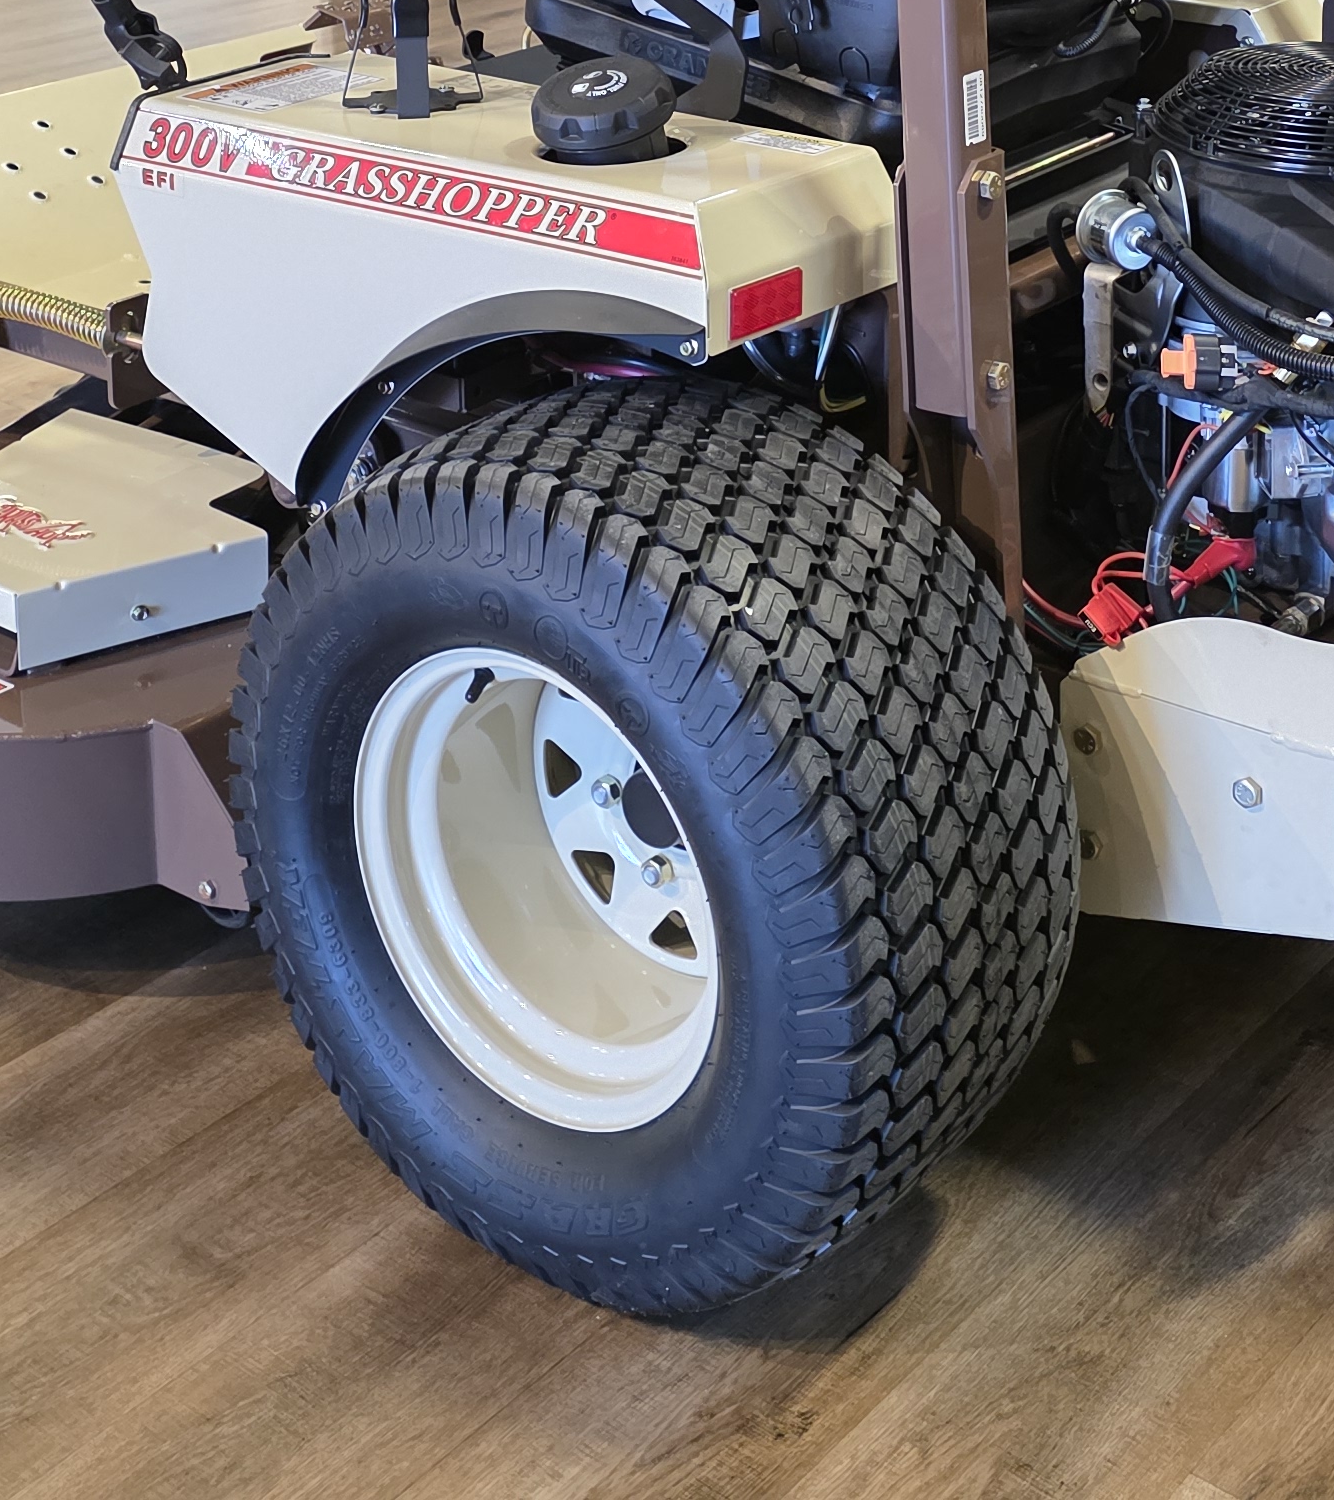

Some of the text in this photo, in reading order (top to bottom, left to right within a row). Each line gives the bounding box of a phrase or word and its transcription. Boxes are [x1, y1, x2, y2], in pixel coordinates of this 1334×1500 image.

[141, 167, 175, 191] EFI
[269, 147, 608, 247] GRASSHOPPER
[316, 910, 426, 1094] 1-800-833-6309
[427, 1095, 477, 1142] CALL
[482, 1140, 563, 1188] SERVICE
